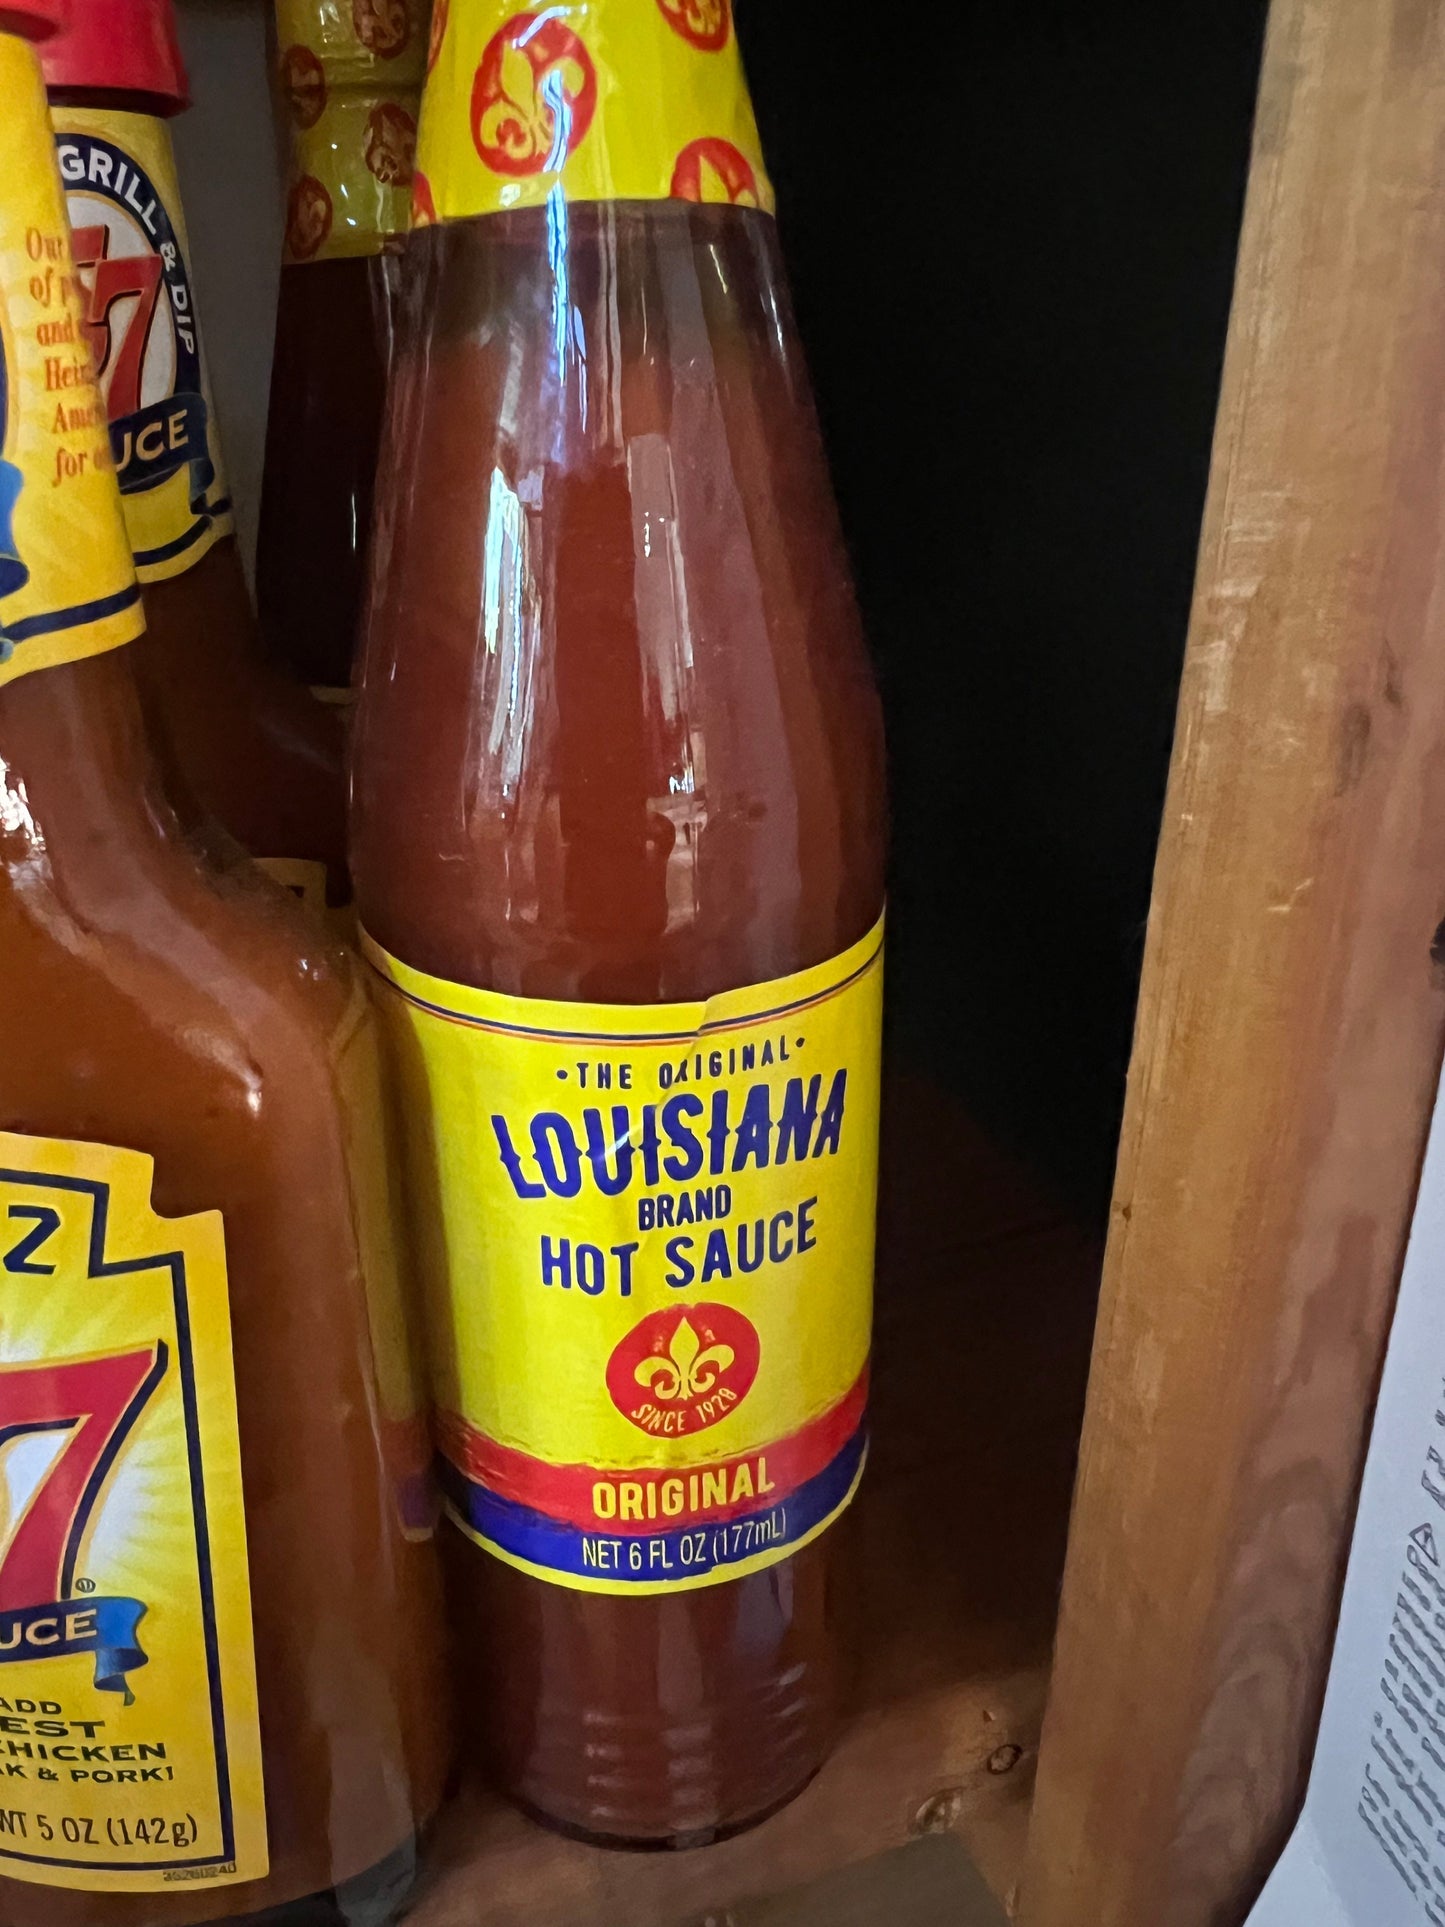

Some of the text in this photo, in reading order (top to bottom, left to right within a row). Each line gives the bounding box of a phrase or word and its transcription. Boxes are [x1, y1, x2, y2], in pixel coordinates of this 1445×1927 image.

[26, 227, 63, 261] Our
[58, 144, 195, 354] GRILL & DIP
[576, 1034, 790, 1090] THE ORIGINAL
[490, 1068, 848, 1199] LOUISIANA
[638, 1184, 732, 1231] BRAND
[540, 1195, 818, 1297] HOT SAUCE
[631, 1387, 738, 1433] SINCE 1928
[592, 1457, 776, 1521] ORIGINAL
[582, 1507, 787, 1570] NET 6 FL OZ (177mL)
[38, 1767, 59, 1782] &
[70, 1765, 175, 1784] PORK!
[36, 1814, 54, 1841] 5
[61, 1817, 101, 1845] OZ
[106, 1813, 198, 1848] (142g)
